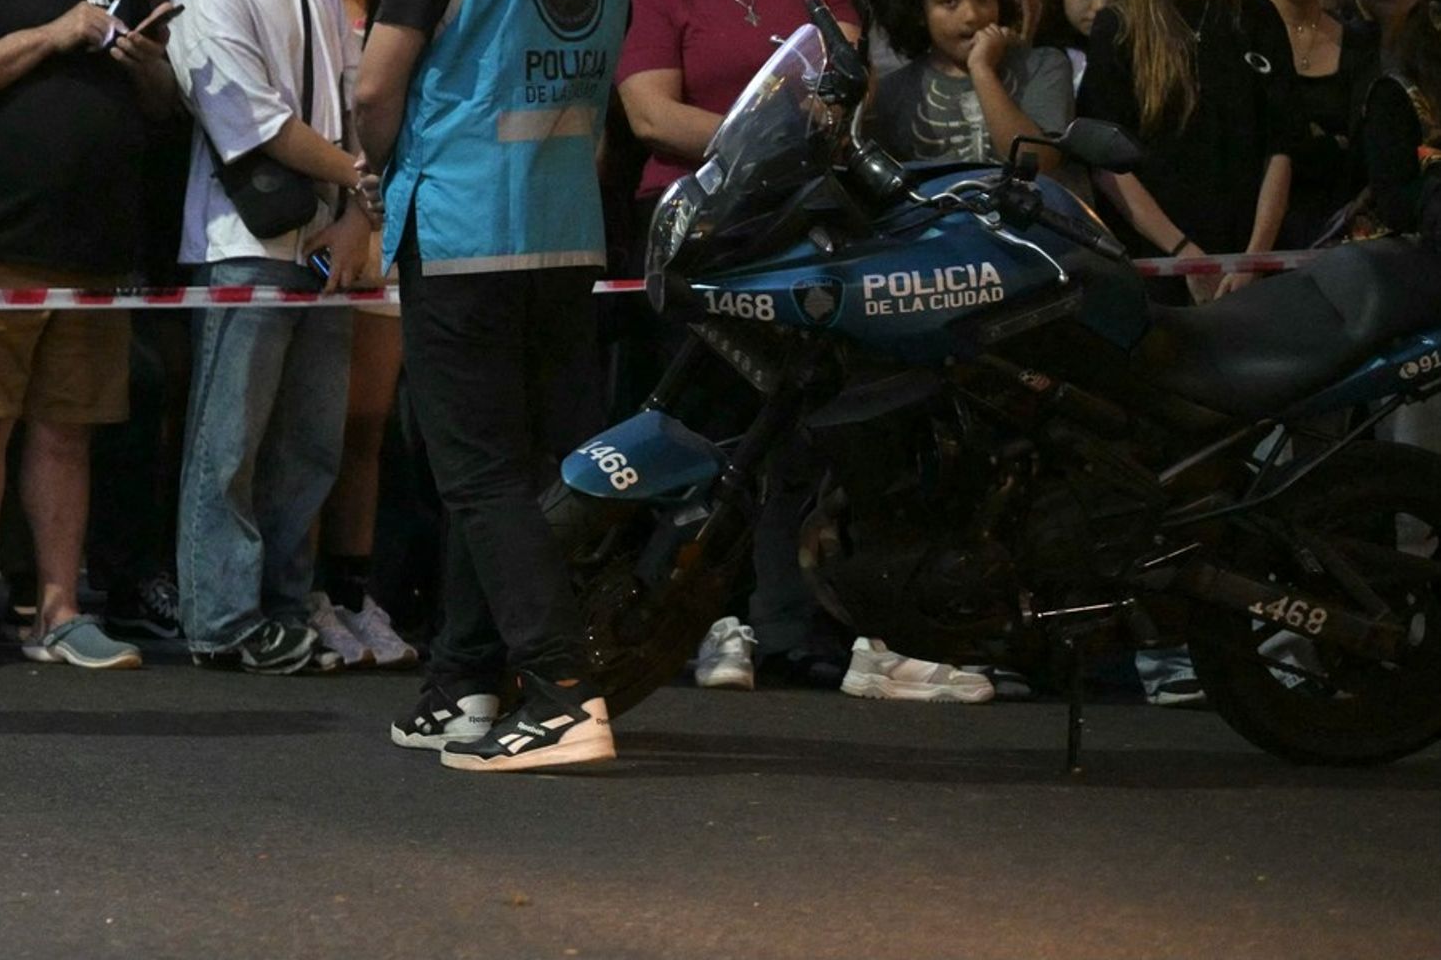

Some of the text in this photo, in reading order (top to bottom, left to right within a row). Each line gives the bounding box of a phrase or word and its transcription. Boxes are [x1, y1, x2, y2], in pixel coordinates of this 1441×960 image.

[525, 85, 546, 104] DE
[862, 262, 1002, 300] POLICIA
[704, 290, 776, 322] 1468
[865, 286, 1005, 316] DE LA CIUDAD
[577, 441, 639, 491] 1468
